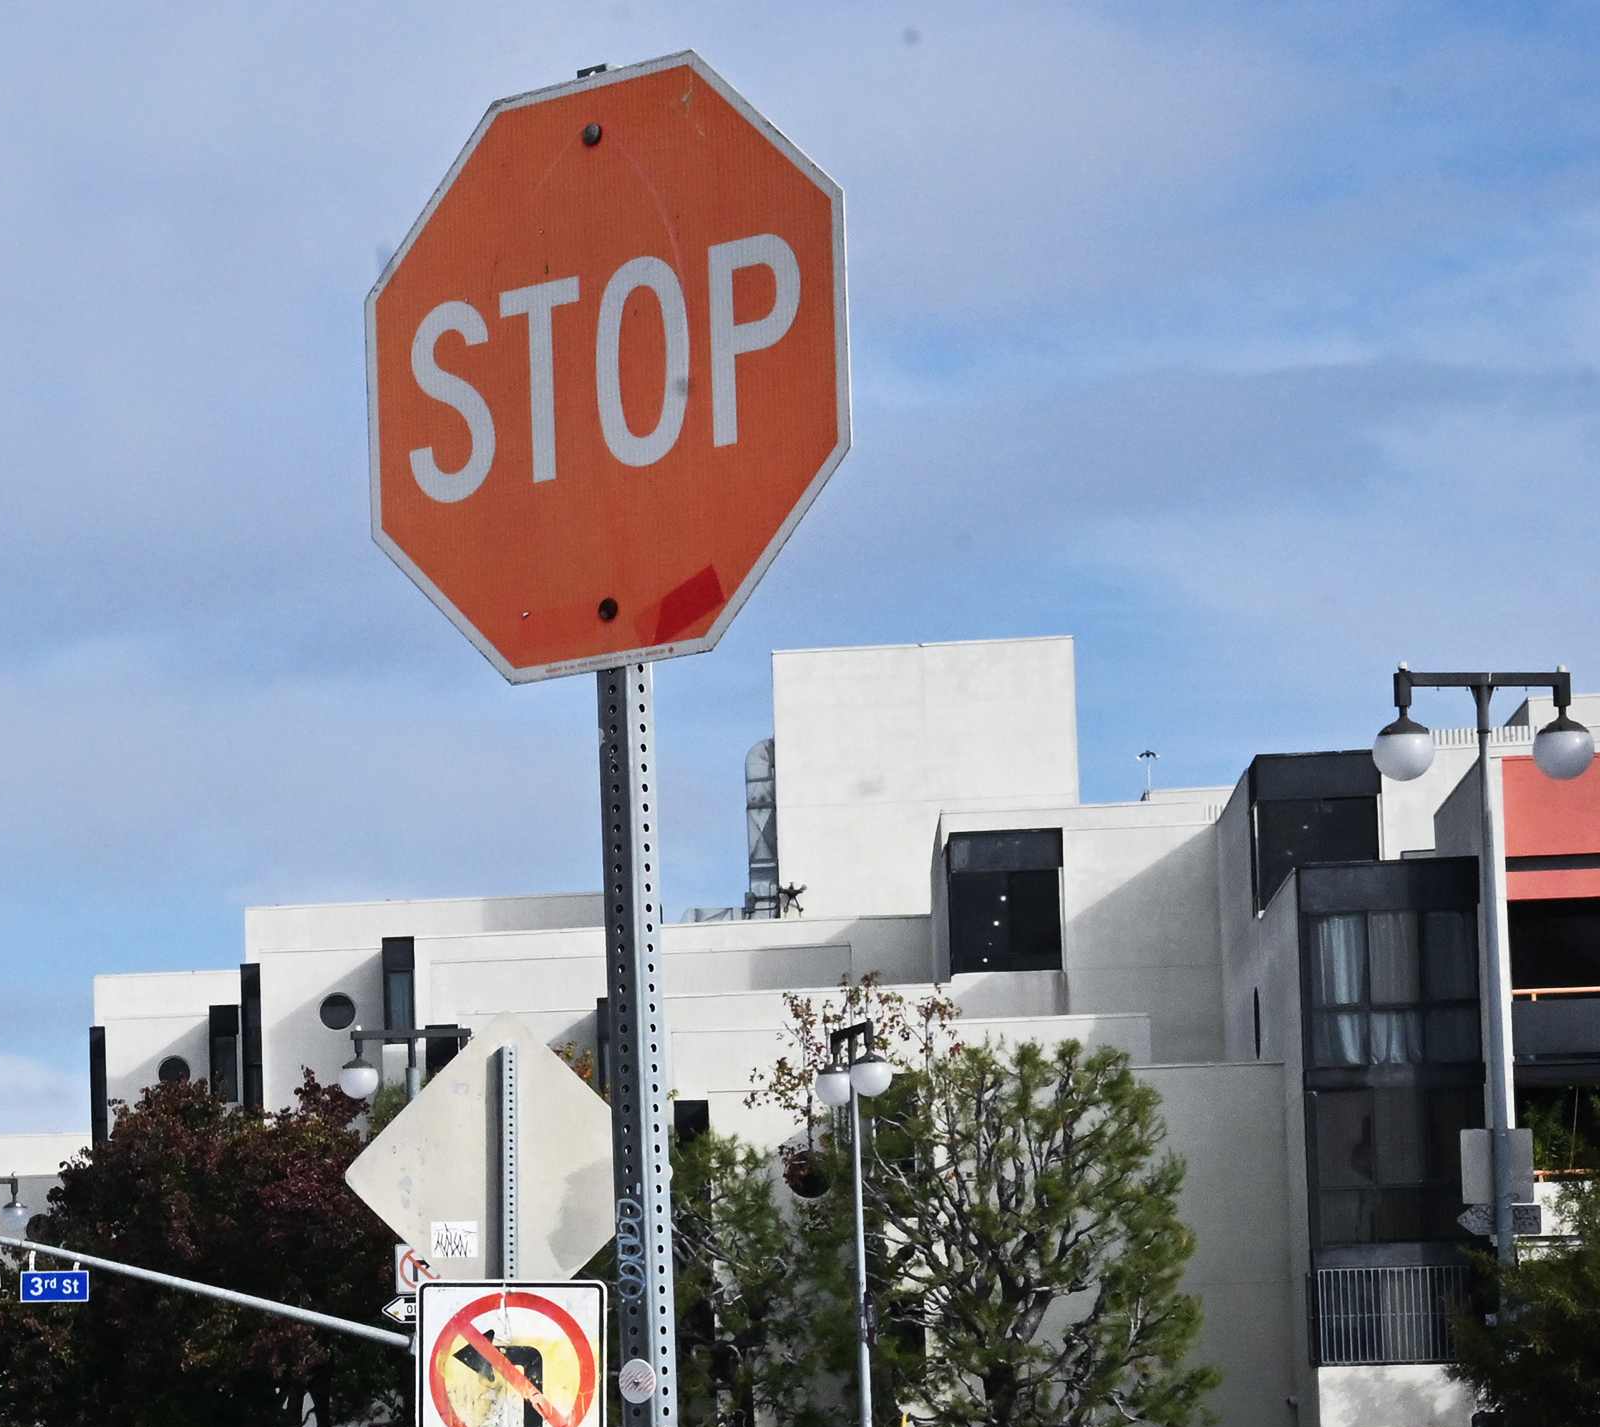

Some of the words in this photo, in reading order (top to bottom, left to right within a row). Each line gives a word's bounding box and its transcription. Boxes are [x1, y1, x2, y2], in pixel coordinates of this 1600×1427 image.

[409, 233, 800, 503] STOP
[30, 1276, 57, 1296] 3rd
[62, 1278, 80, 1294] St
